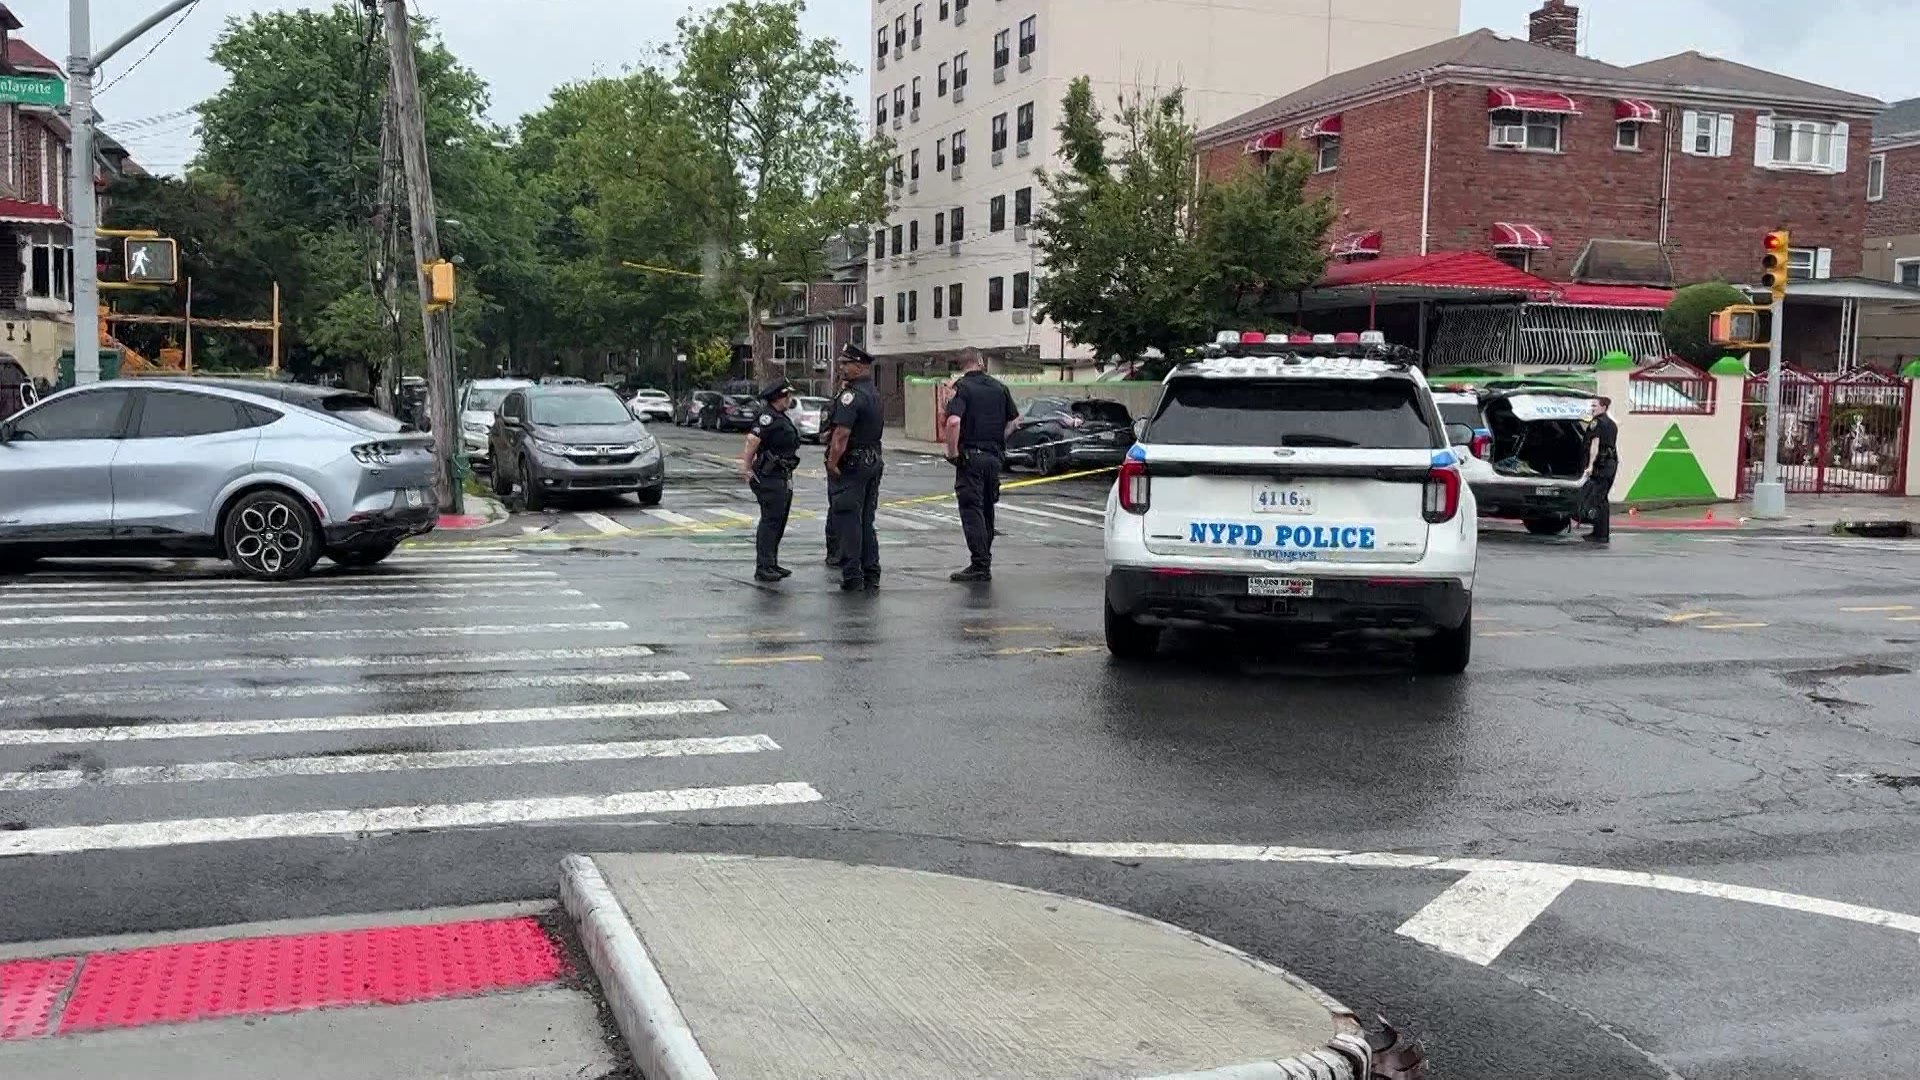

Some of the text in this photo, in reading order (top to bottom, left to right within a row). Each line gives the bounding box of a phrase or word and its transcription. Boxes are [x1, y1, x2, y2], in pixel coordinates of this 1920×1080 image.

[0, 80, 51, 95] afayette
[1259, 491, 1298, 506] 4116
[1189, 522, 1376, 549] NYPD POLICE
